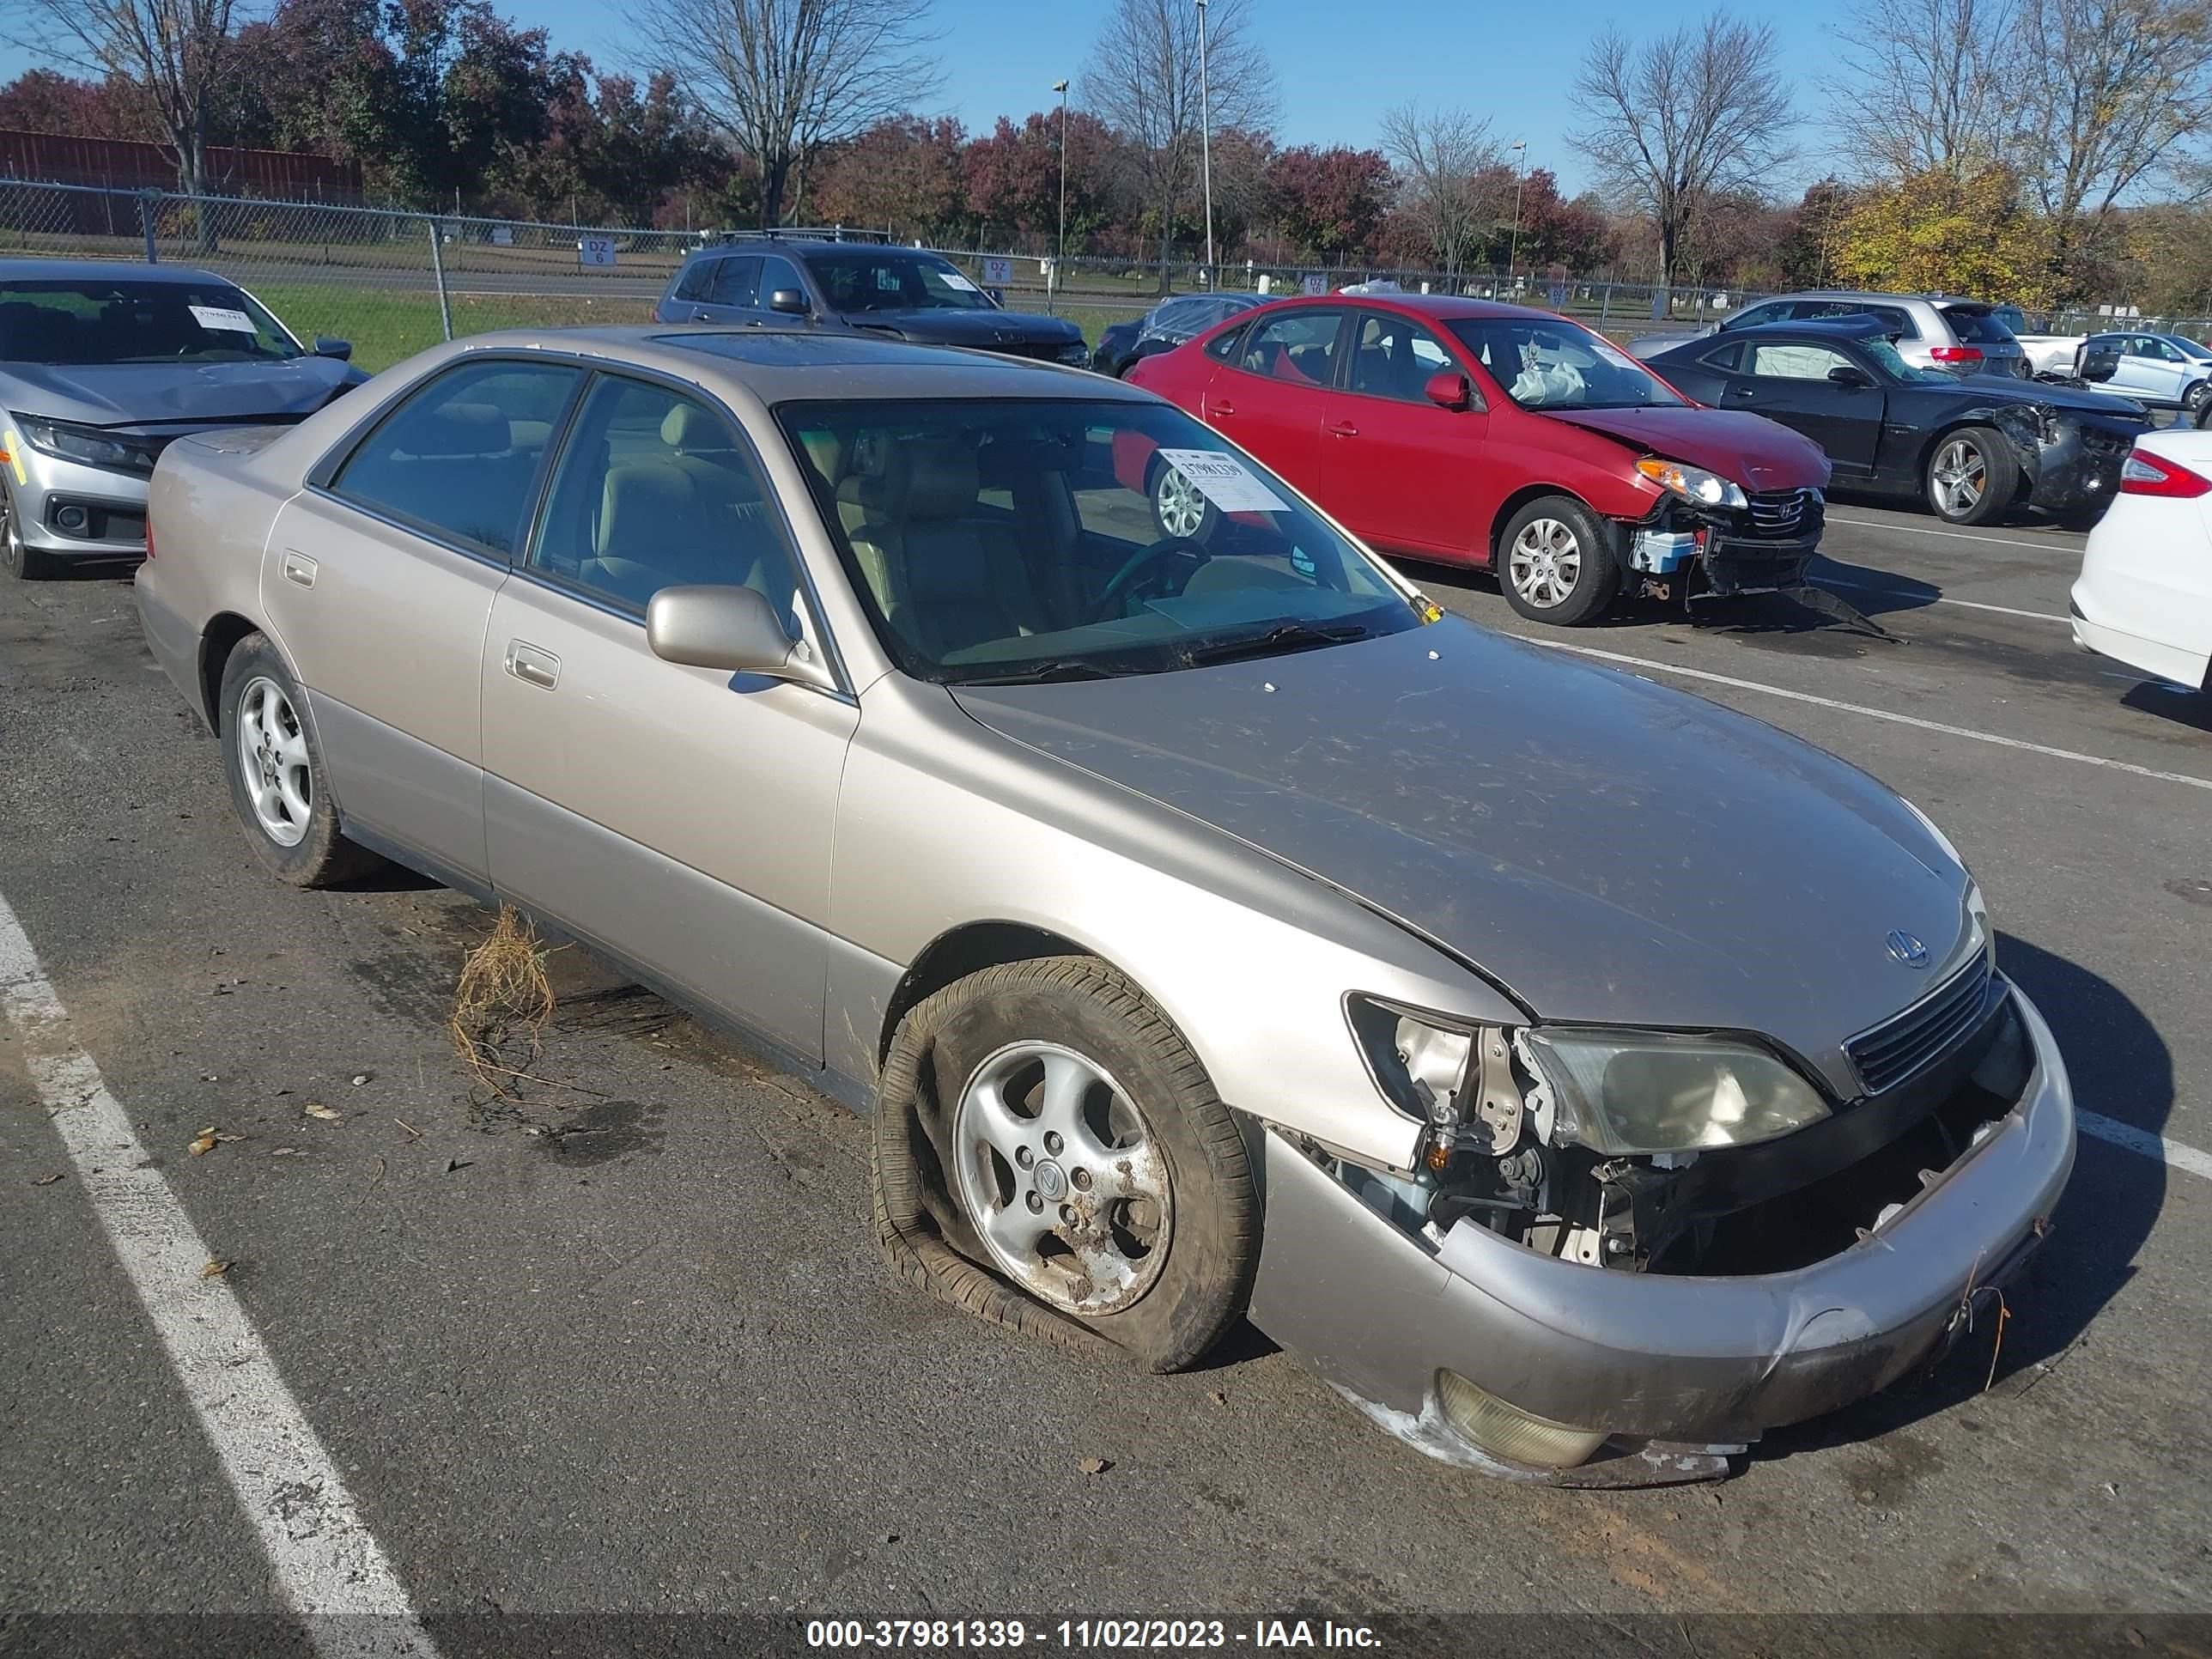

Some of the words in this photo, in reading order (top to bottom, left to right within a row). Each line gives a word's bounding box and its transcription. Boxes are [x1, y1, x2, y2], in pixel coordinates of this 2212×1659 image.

[589, 240, 608, 252] DZ
[596, 252, 604, 263] 6
[991, 261, 1006, 271] DZ
[1310, 277, 1322, 286] DZ
[1311, 286, 1321, 295] 10
[1182, 463, 1243, 476] 37981339
